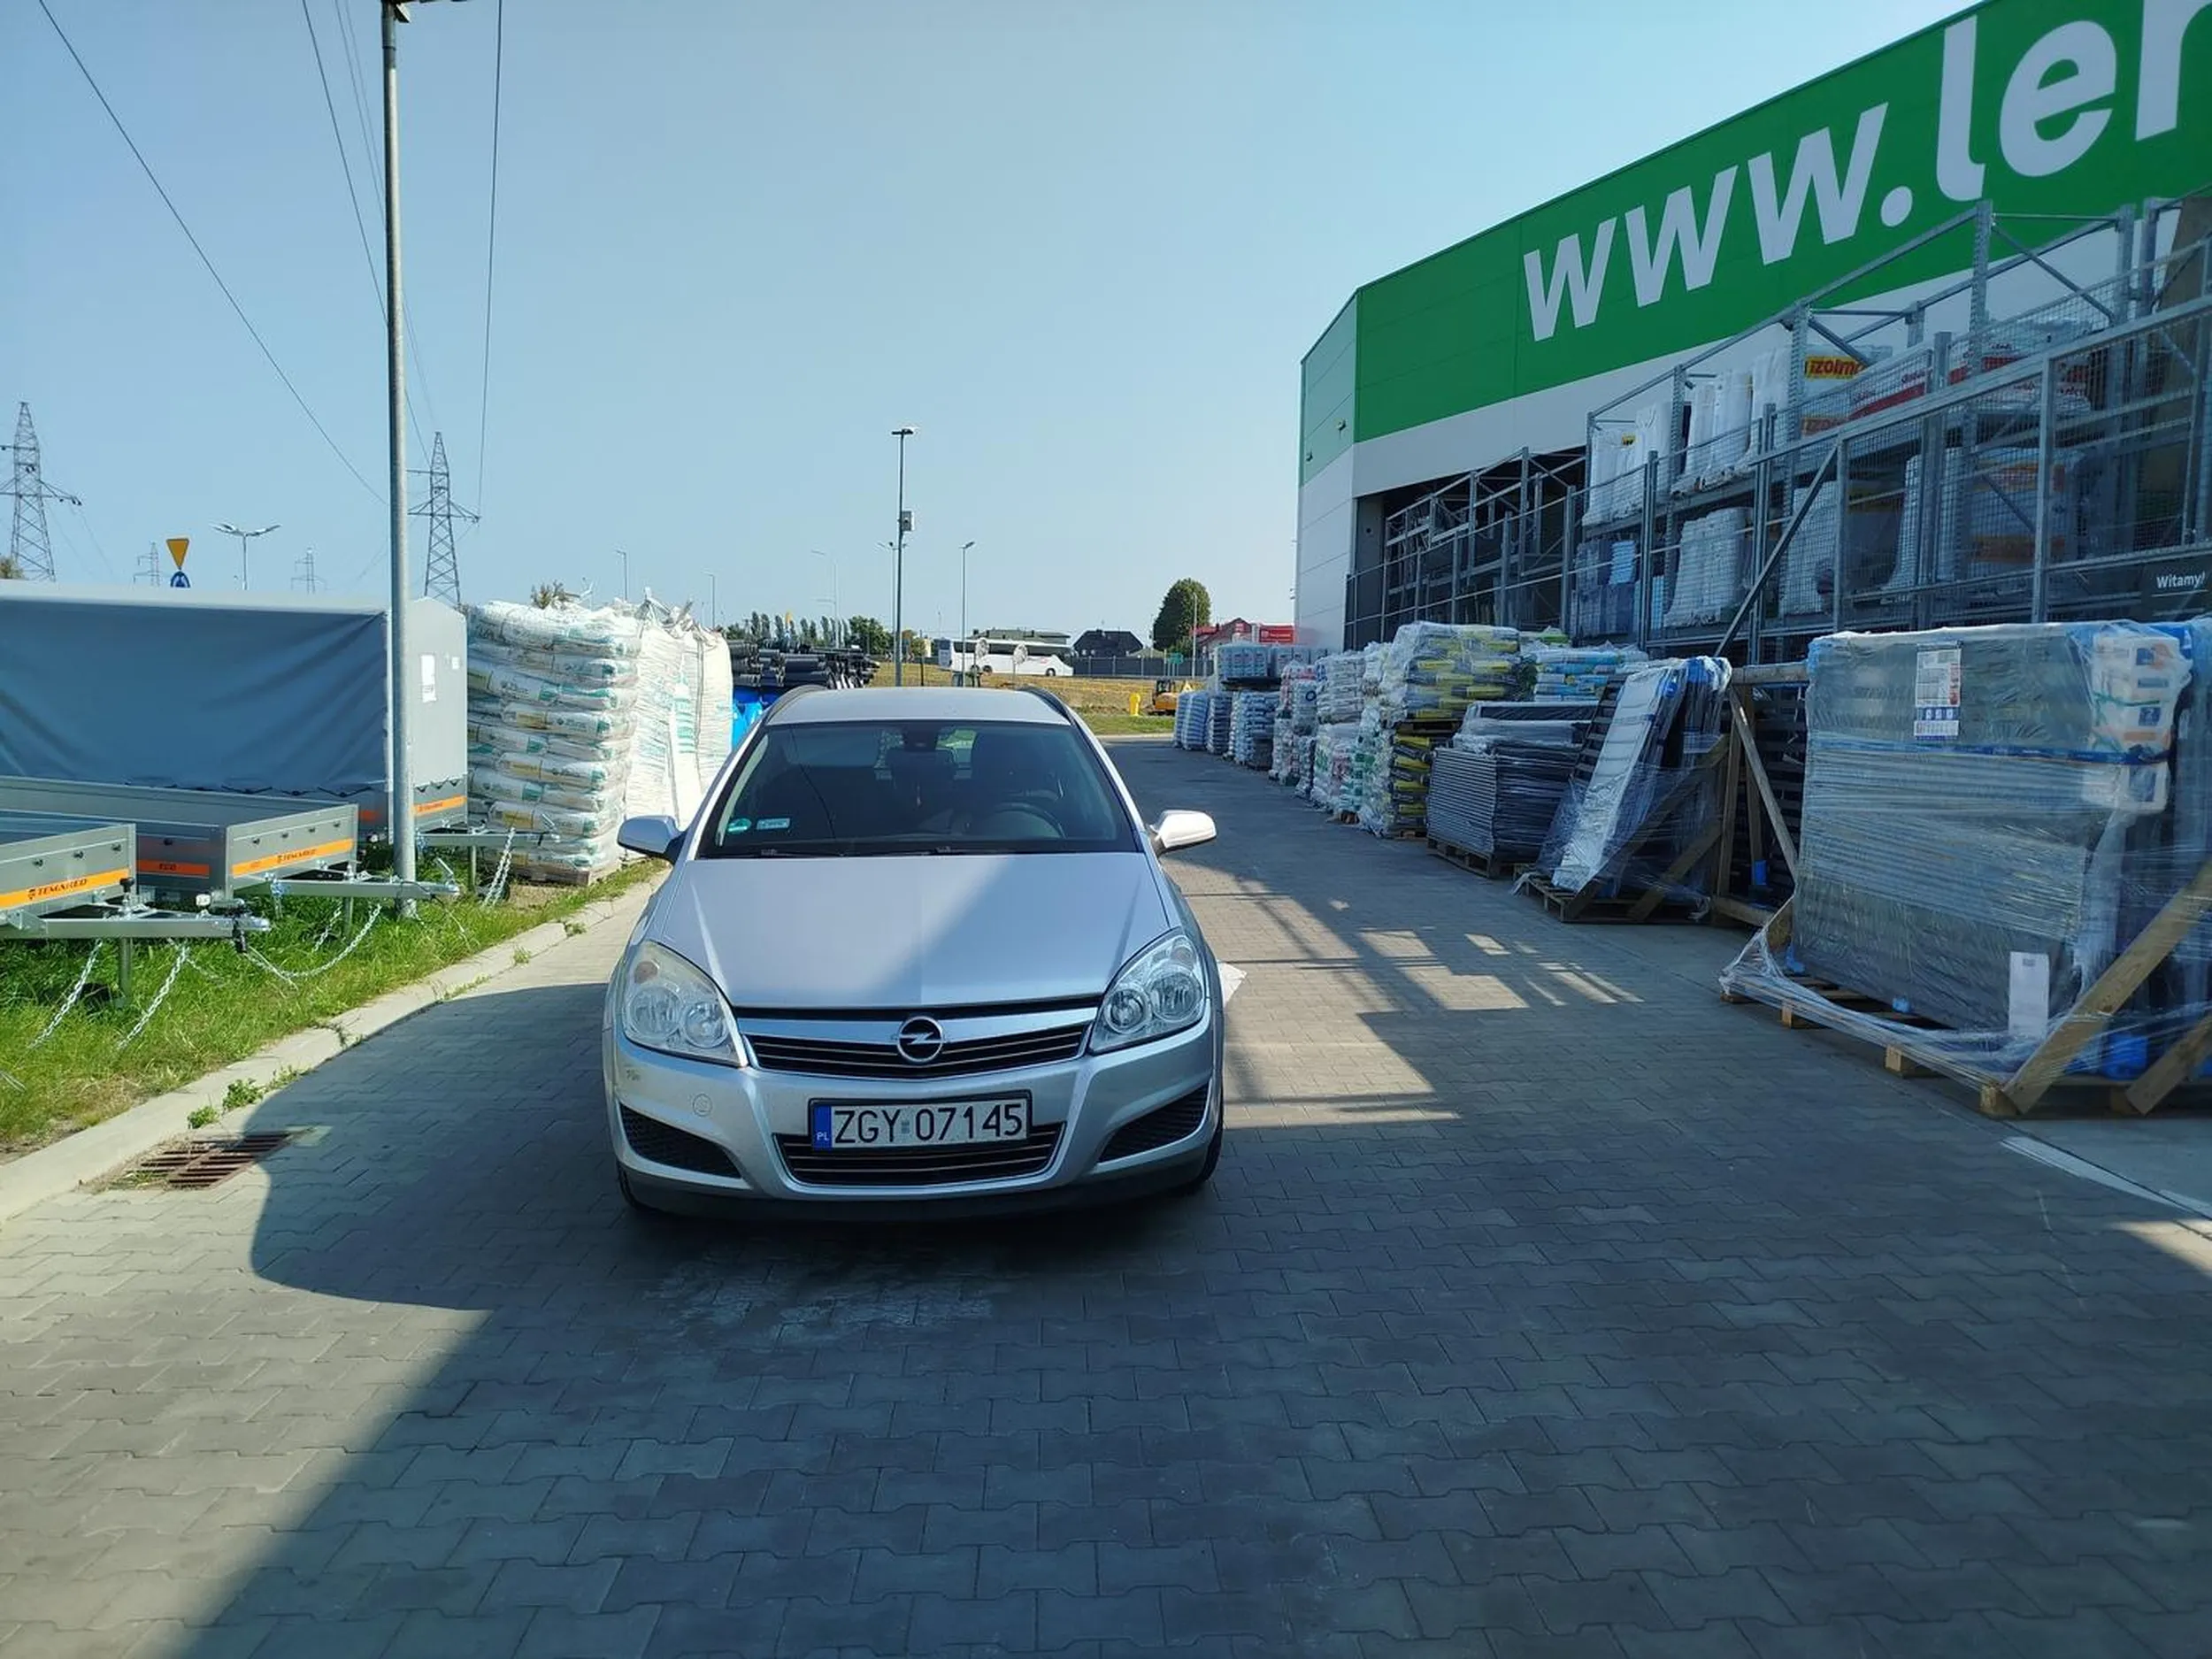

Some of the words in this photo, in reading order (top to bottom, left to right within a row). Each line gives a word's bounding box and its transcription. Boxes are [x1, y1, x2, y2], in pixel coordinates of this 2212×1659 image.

[2156, 571, 2206, 588] Witamy!
[834, 1110, 901, 1143] ZGY
[915, 1104, 1023, 1141] 07145
[817, 1133, 829, 1141] PL
